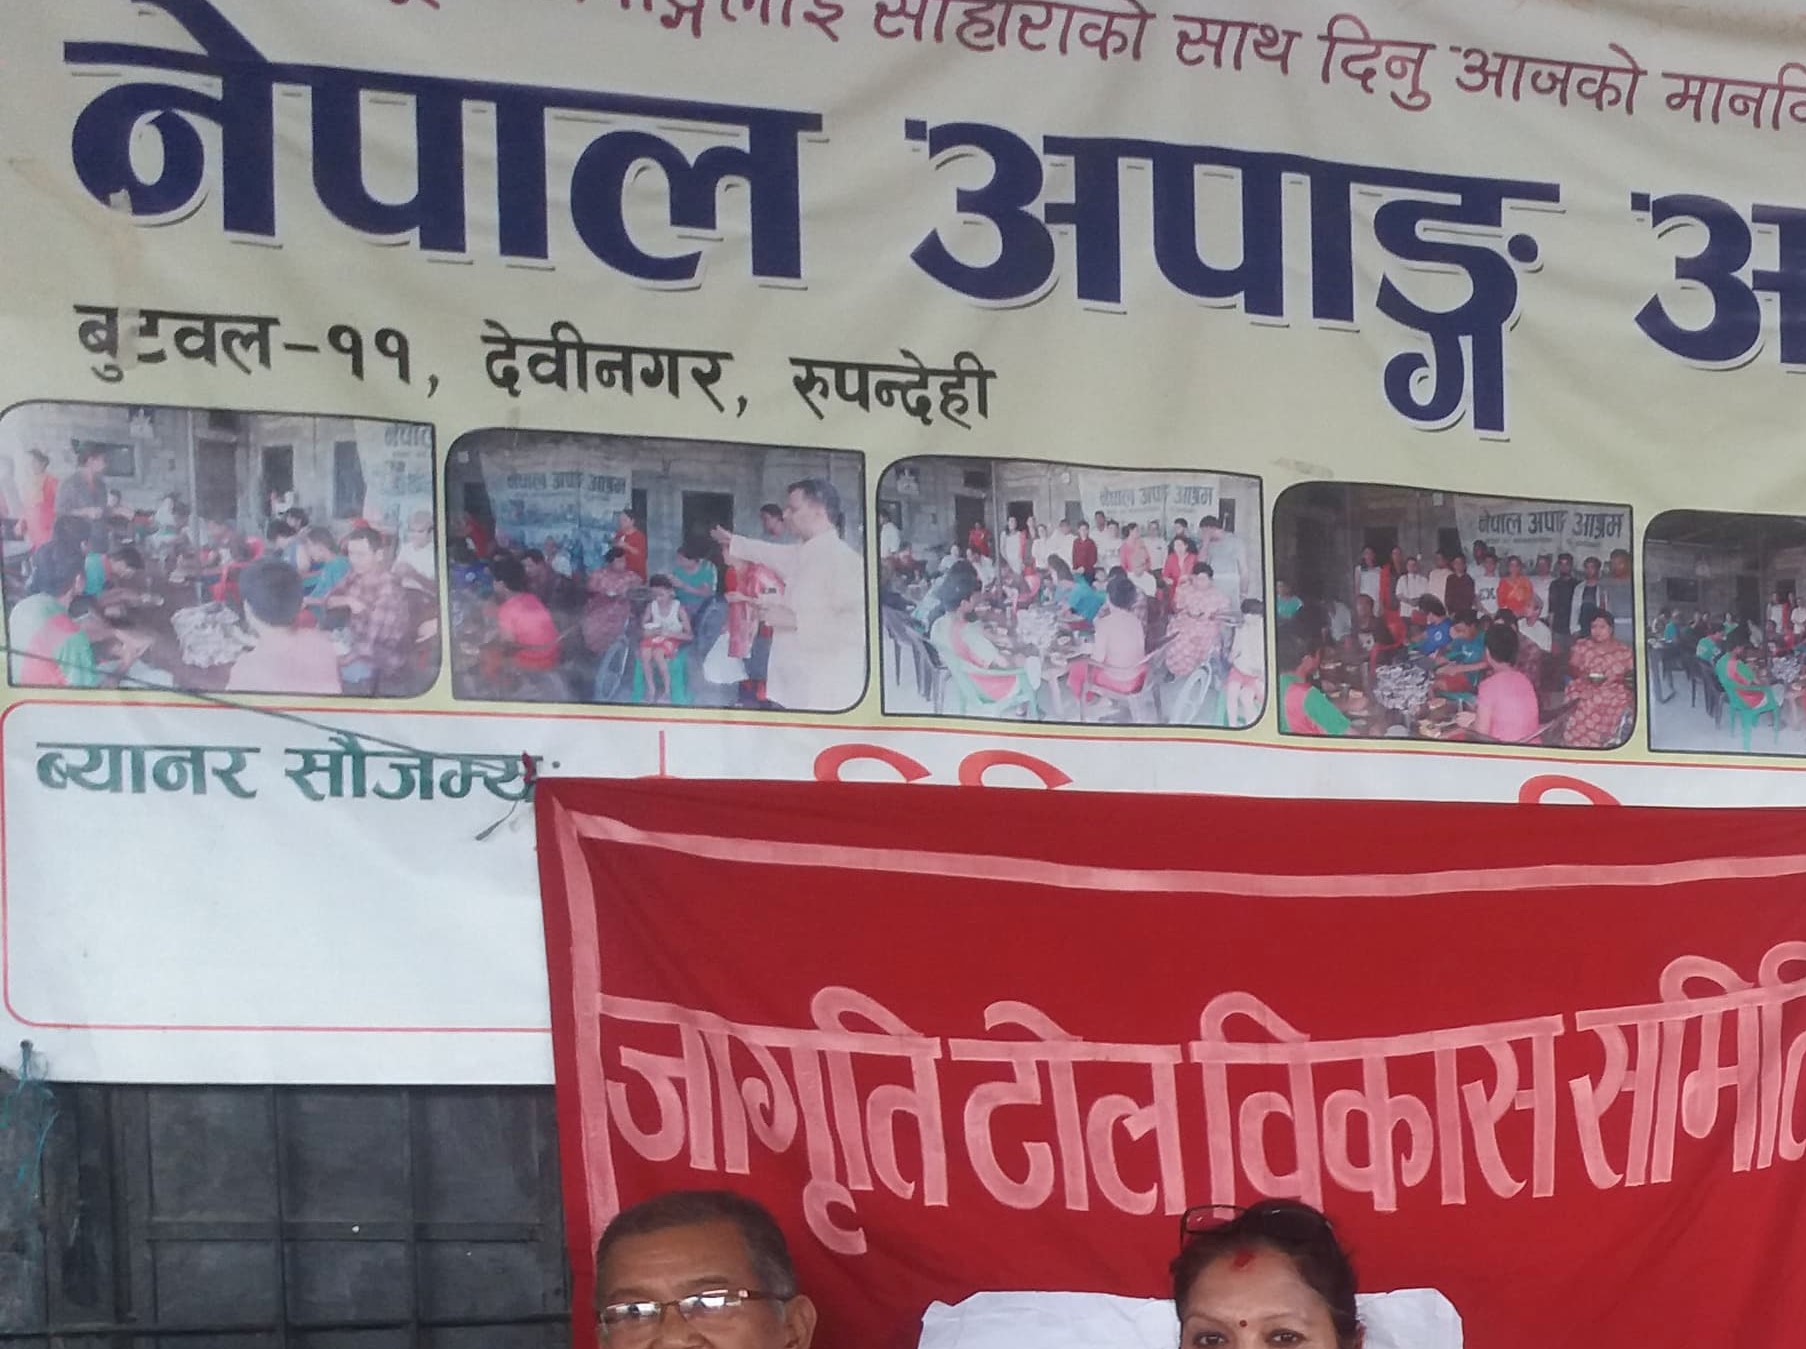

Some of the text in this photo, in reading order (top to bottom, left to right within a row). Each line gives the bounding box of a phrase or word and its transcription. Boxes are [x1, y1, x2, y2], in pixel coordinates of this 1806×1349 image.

[1173, 14, 1302, 74] साथ
[1320, 14, 1439, 111] दिनु
[1449, 42, 1647, 116] आजको
[64, 0, 829, 290] नेपाल
[905, 117, 1562, 440] अपाङ्ग
[790, 349, 997, 429] रुपन्देही
[36, 742, 260, 799] ब्यानर
[600, 986, 943, 1255] जागृति
[949, 1000, 1183, 1216] टोल
[1190, 991, 1565, 1222] विकास
